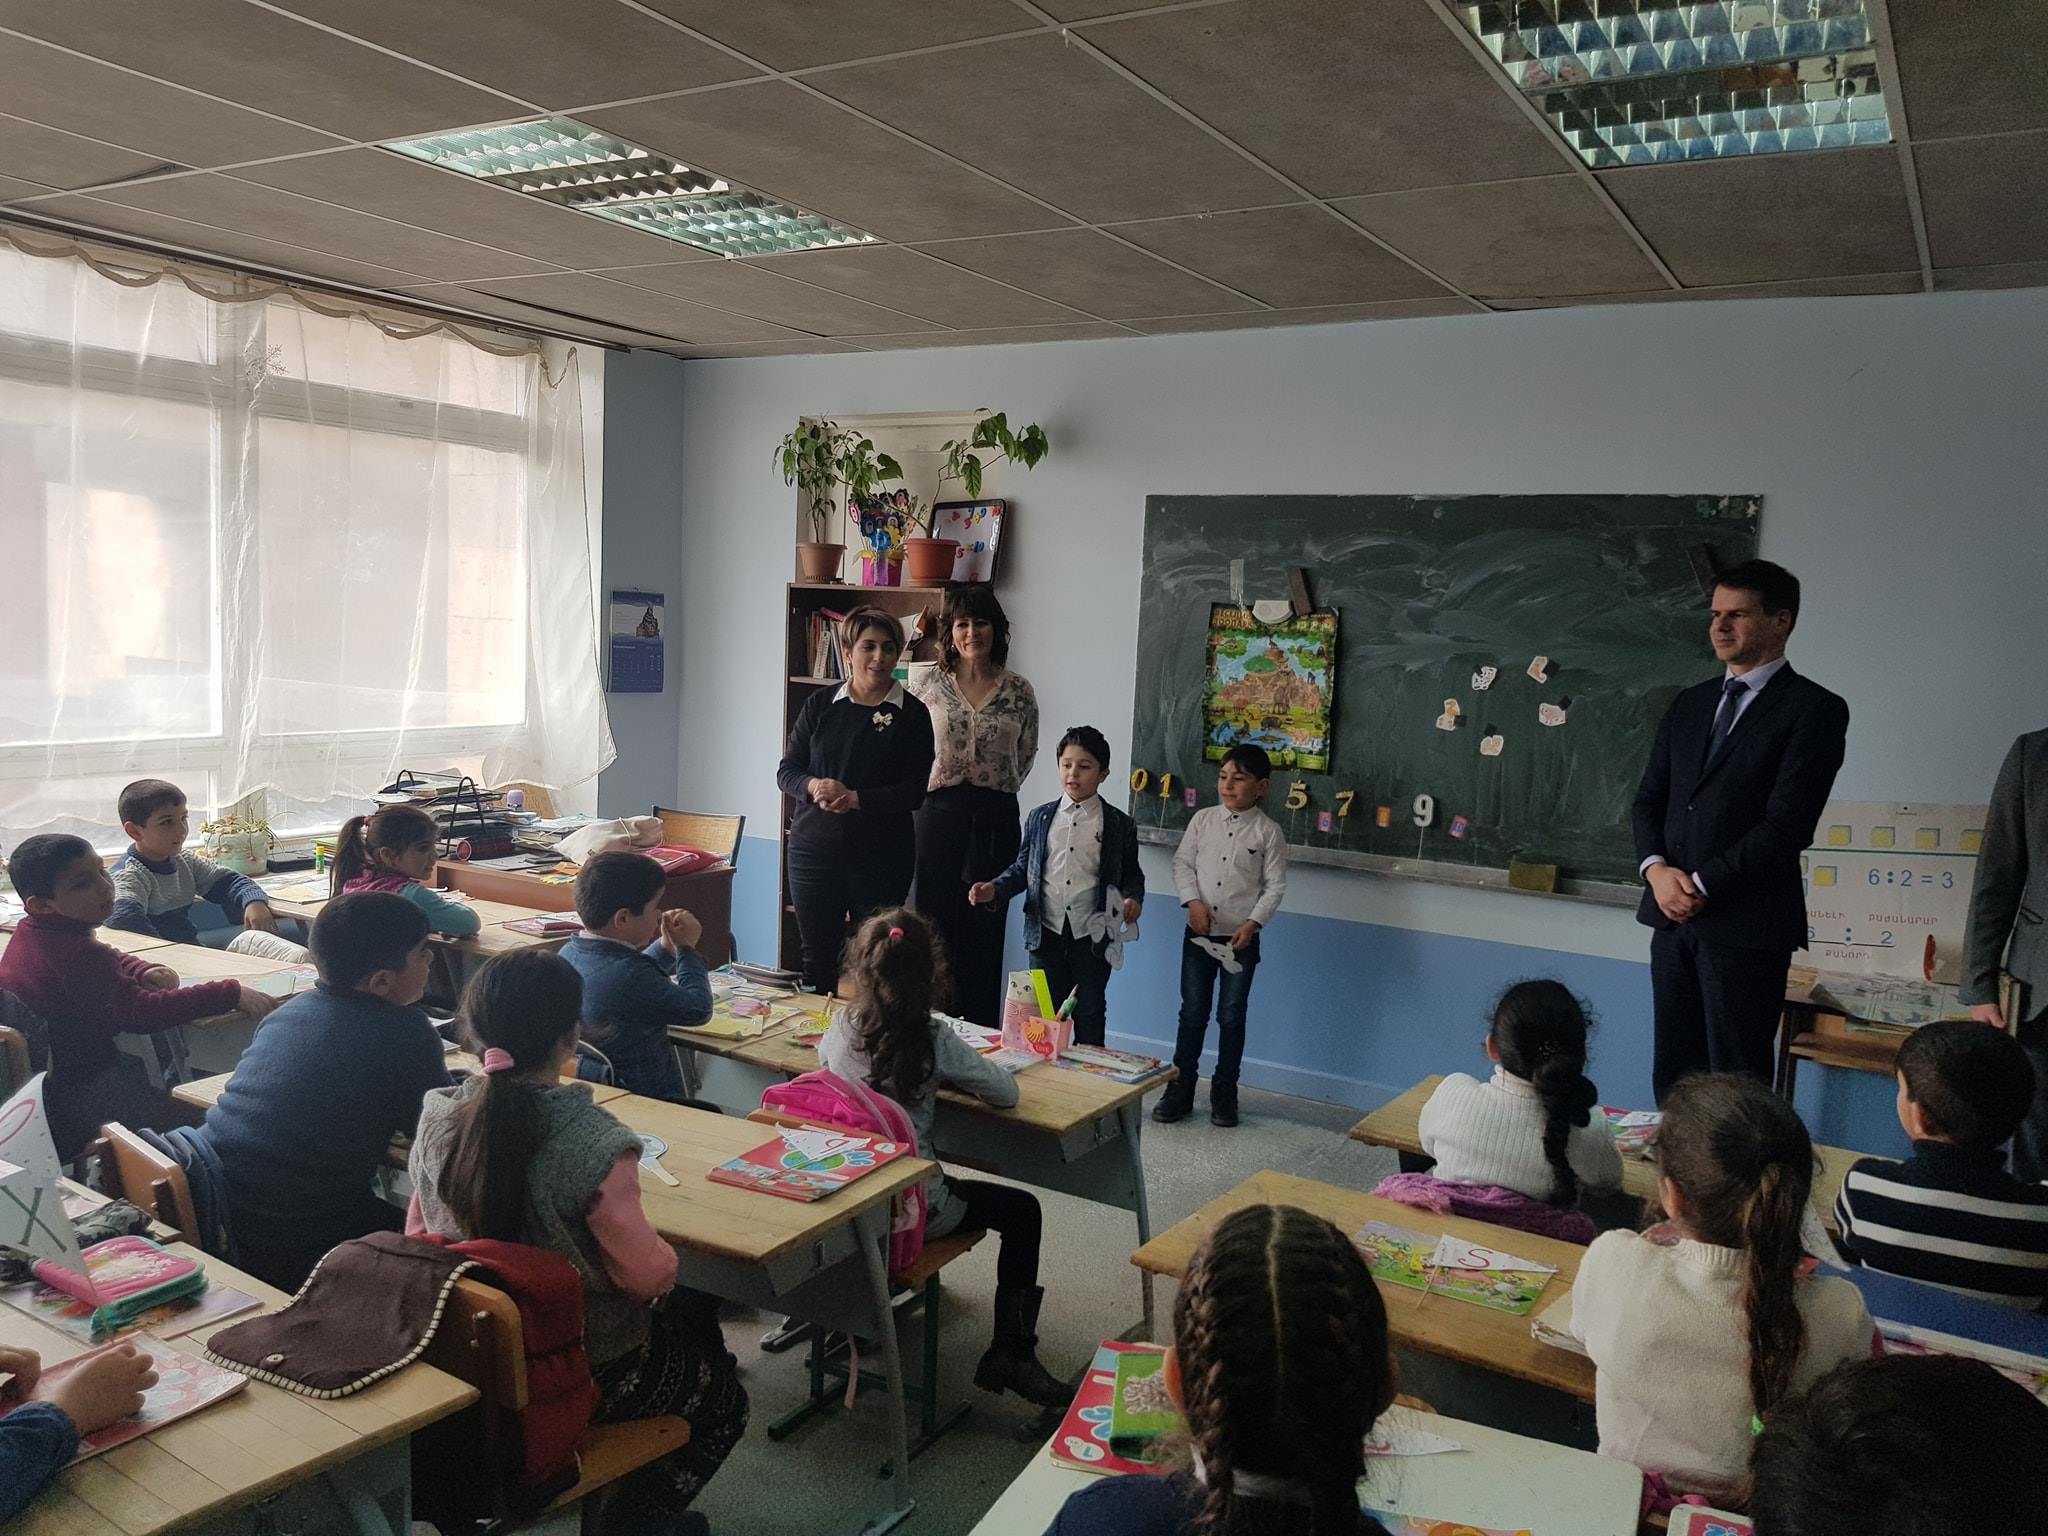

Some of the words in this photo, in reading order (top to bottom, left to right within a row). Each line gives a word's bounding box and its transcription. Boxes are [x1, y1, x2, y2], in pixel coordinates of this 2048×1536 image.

[1131, 768, 1149, 792] 0
[1160, 772, 1172, 798] 1
[1284, 782, 1308, 810] 5
[1335, 790, 1354, 817] 7
[1412, 793, 1435, 828] 9
[1881, 930, 1893, 944] 2
[1457, 1248, 1494, 1269] S
